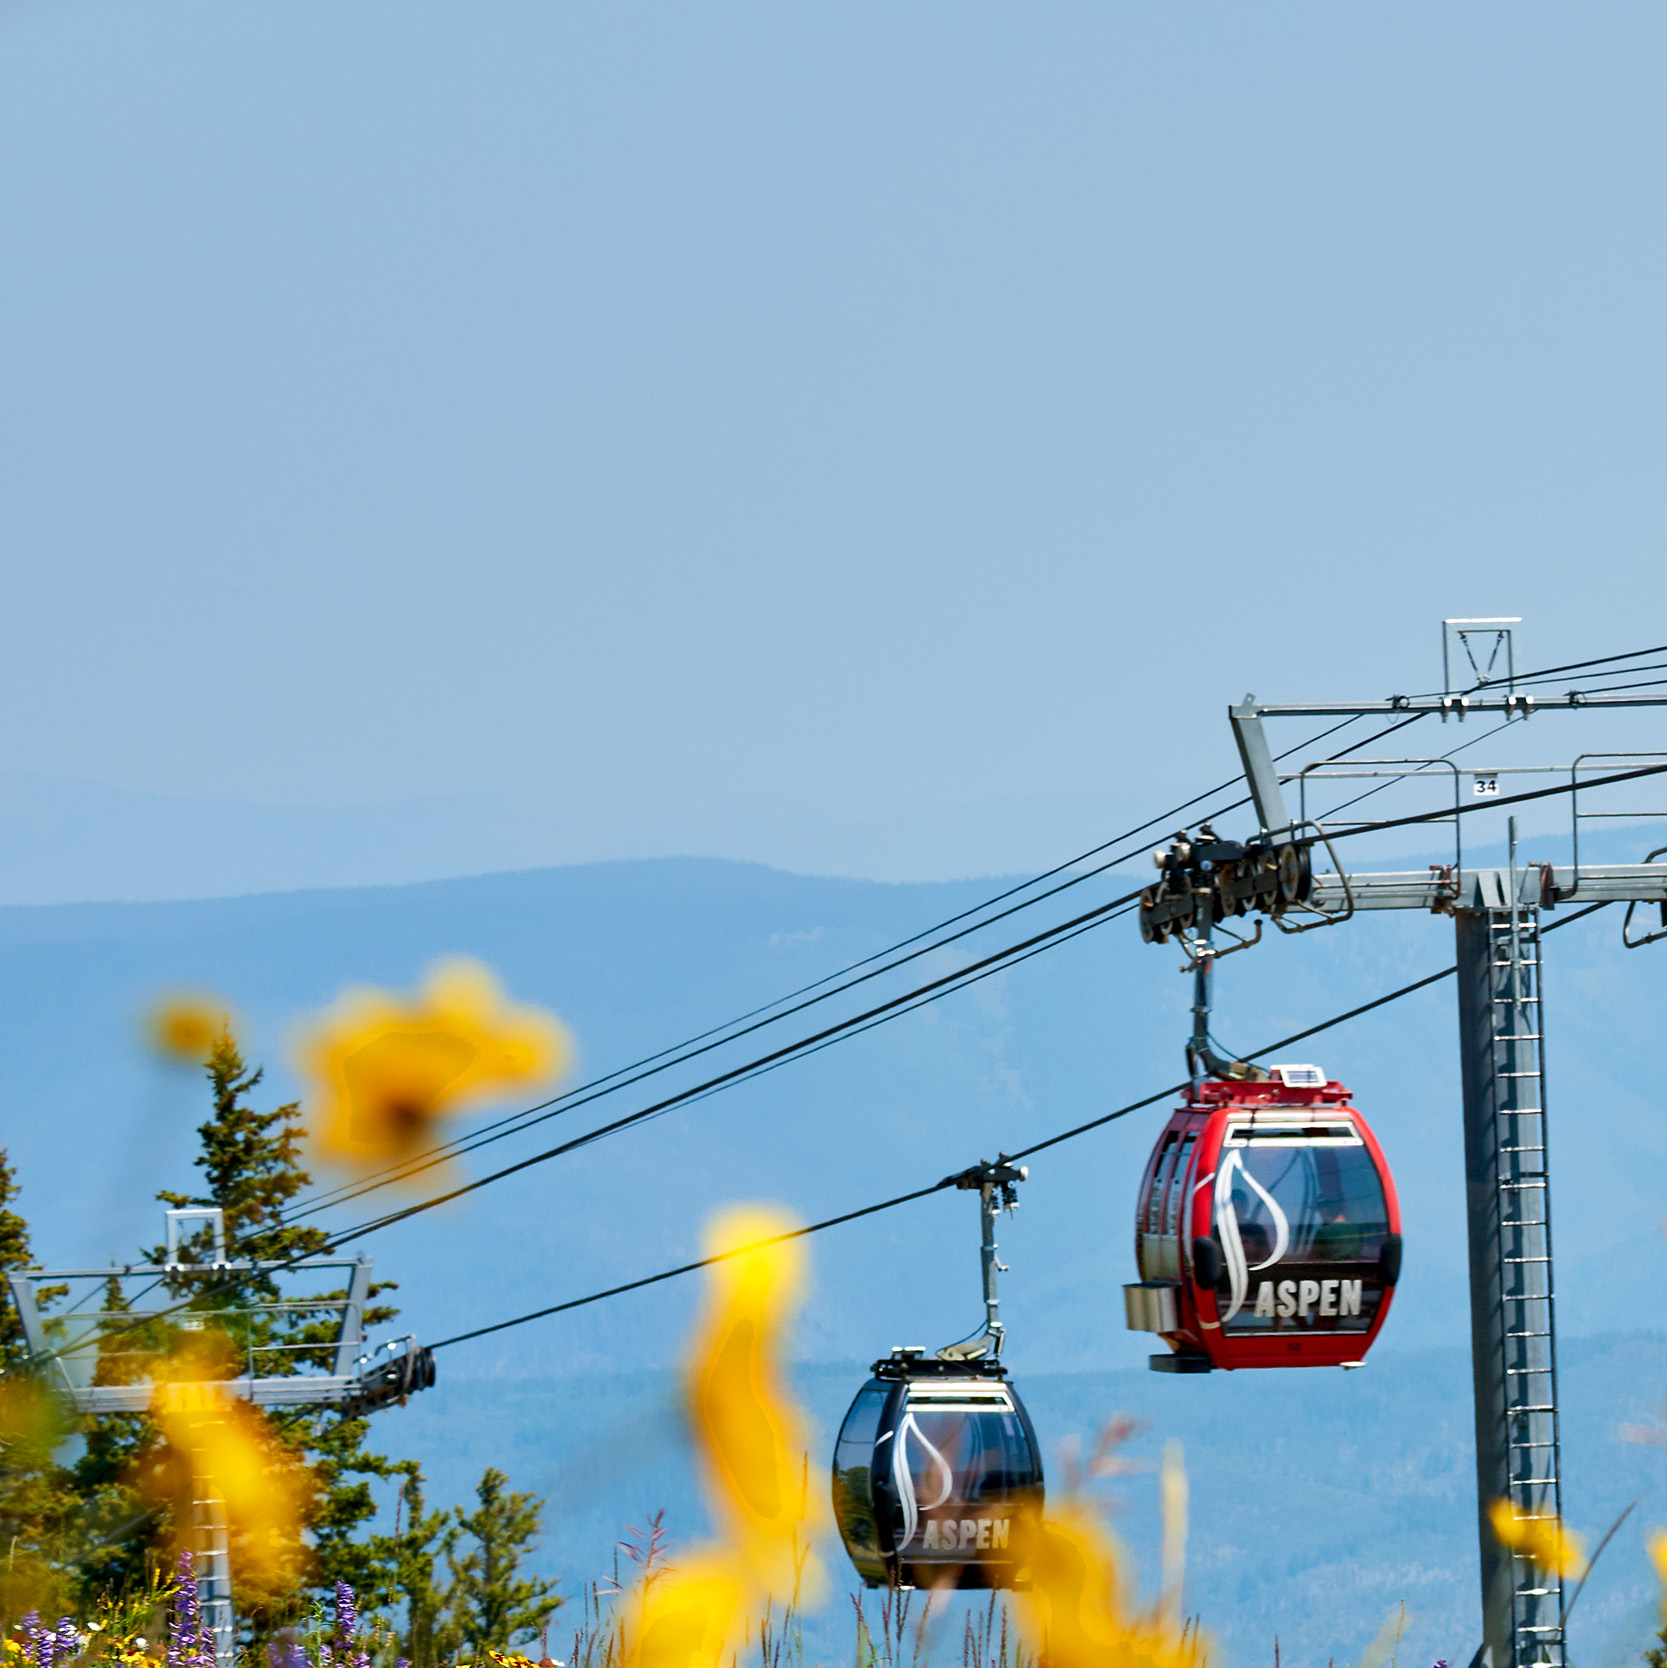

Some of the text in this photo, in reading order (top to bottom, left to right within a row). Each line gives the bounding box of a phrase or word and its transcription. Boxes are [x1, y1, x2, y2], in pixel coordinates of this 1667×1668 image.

[1476, 780, 1497, 793] 34
[1253, 1279, 1363, 1318] ASPEN
[922, 1518, 1011, 1551] ASPEN
